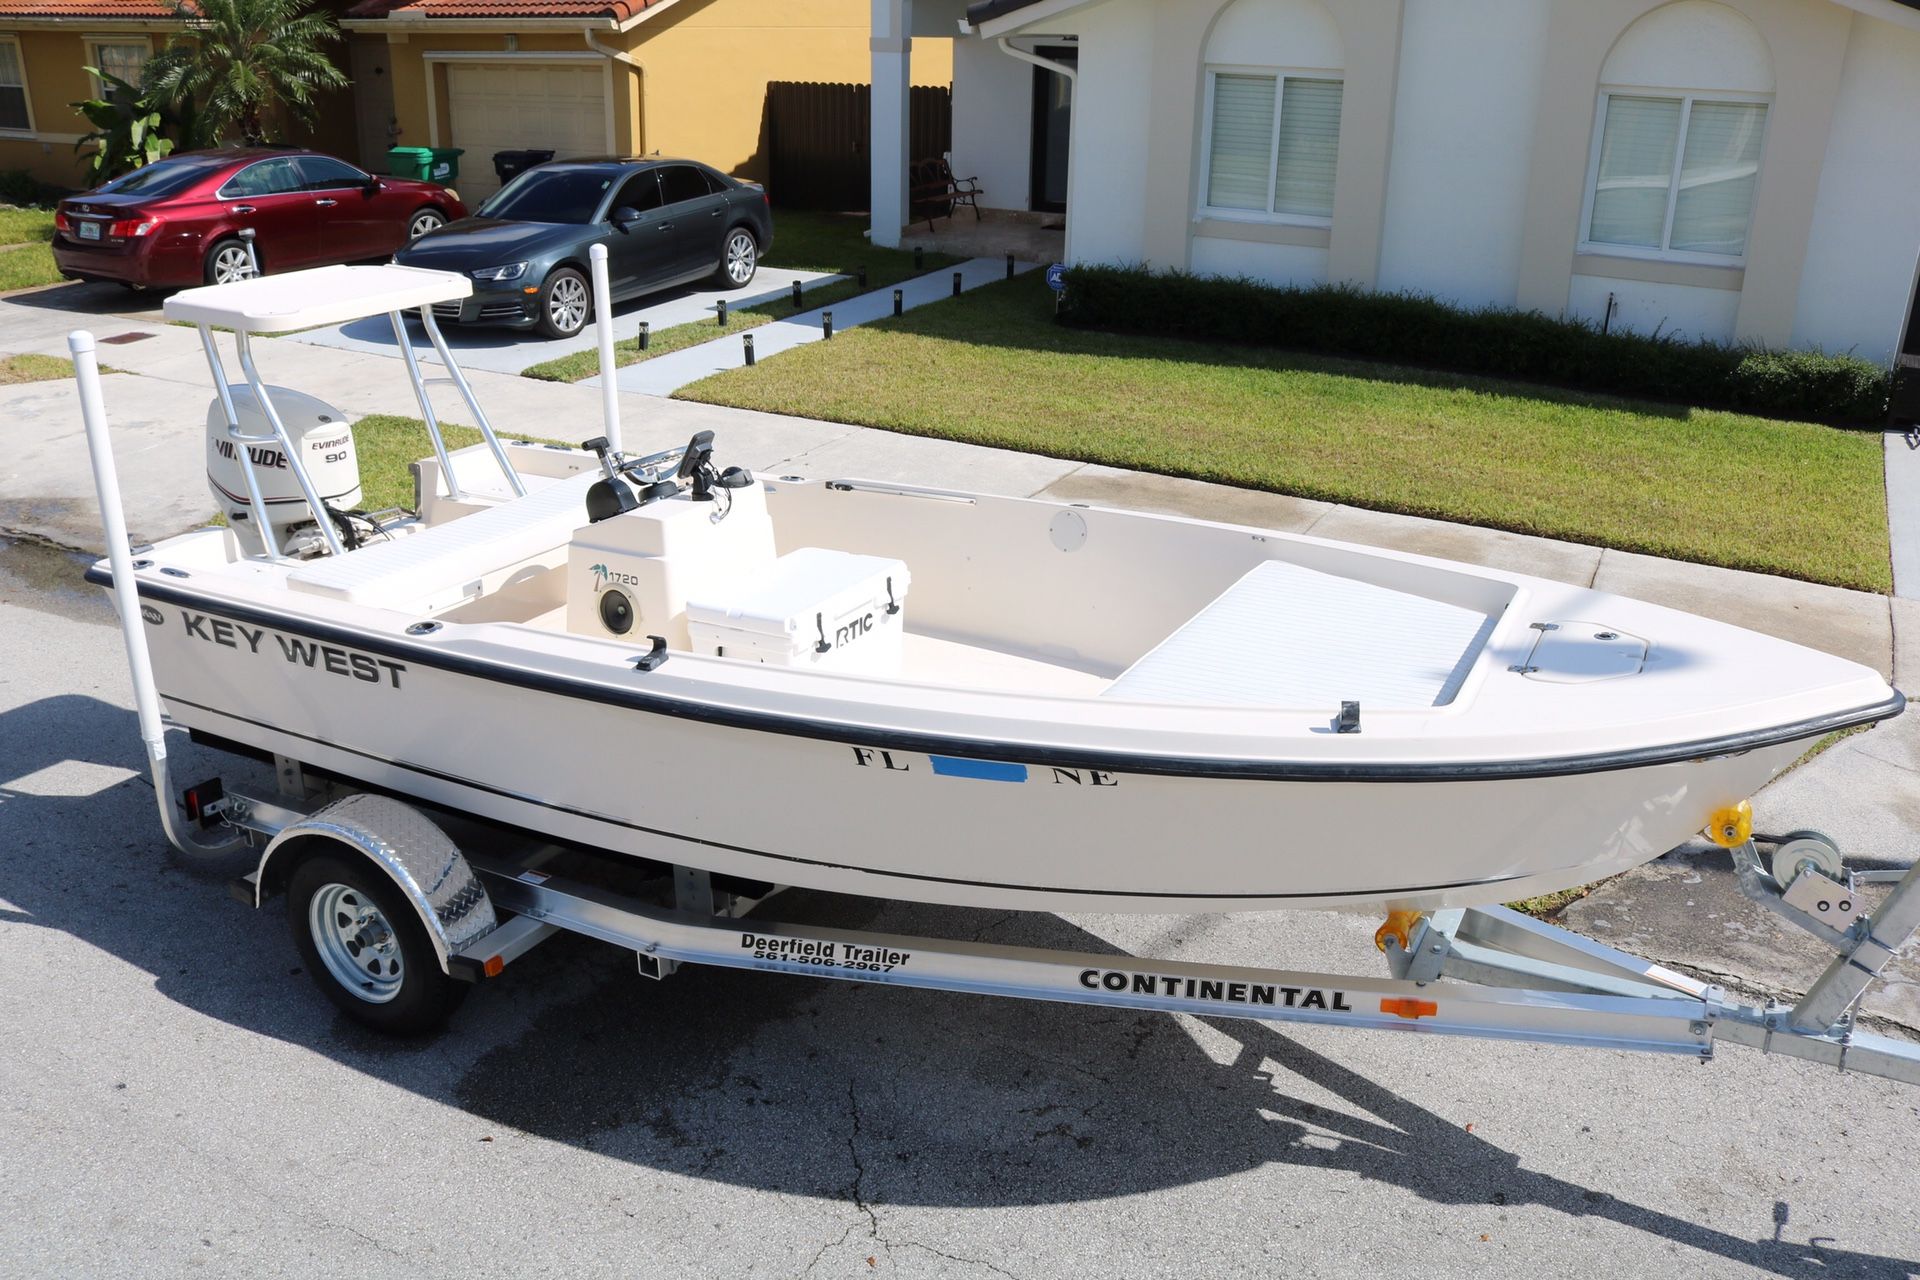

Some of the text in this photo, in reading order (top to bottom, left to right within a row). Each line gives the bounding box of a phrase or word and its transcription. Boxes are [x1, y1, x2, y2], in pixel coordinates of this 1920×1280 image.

[312, 435, 349, 450] EVINRUDE
[325, 451, 347, 463] 90
[609, 571, 639, 586] 1720
[836, 612, 873, 648] RTIC
[181, 611, 406, 690] KEY WEST
[852, 746, 910, 772] FL
[1051, 767, 1118, 787] NE
[741, 933, 911, 966] Deerfield Trailer
[753, 950, 895, 973] 561-506-2967
[1079, 969, 1352, 1012] CONTINENTAL
